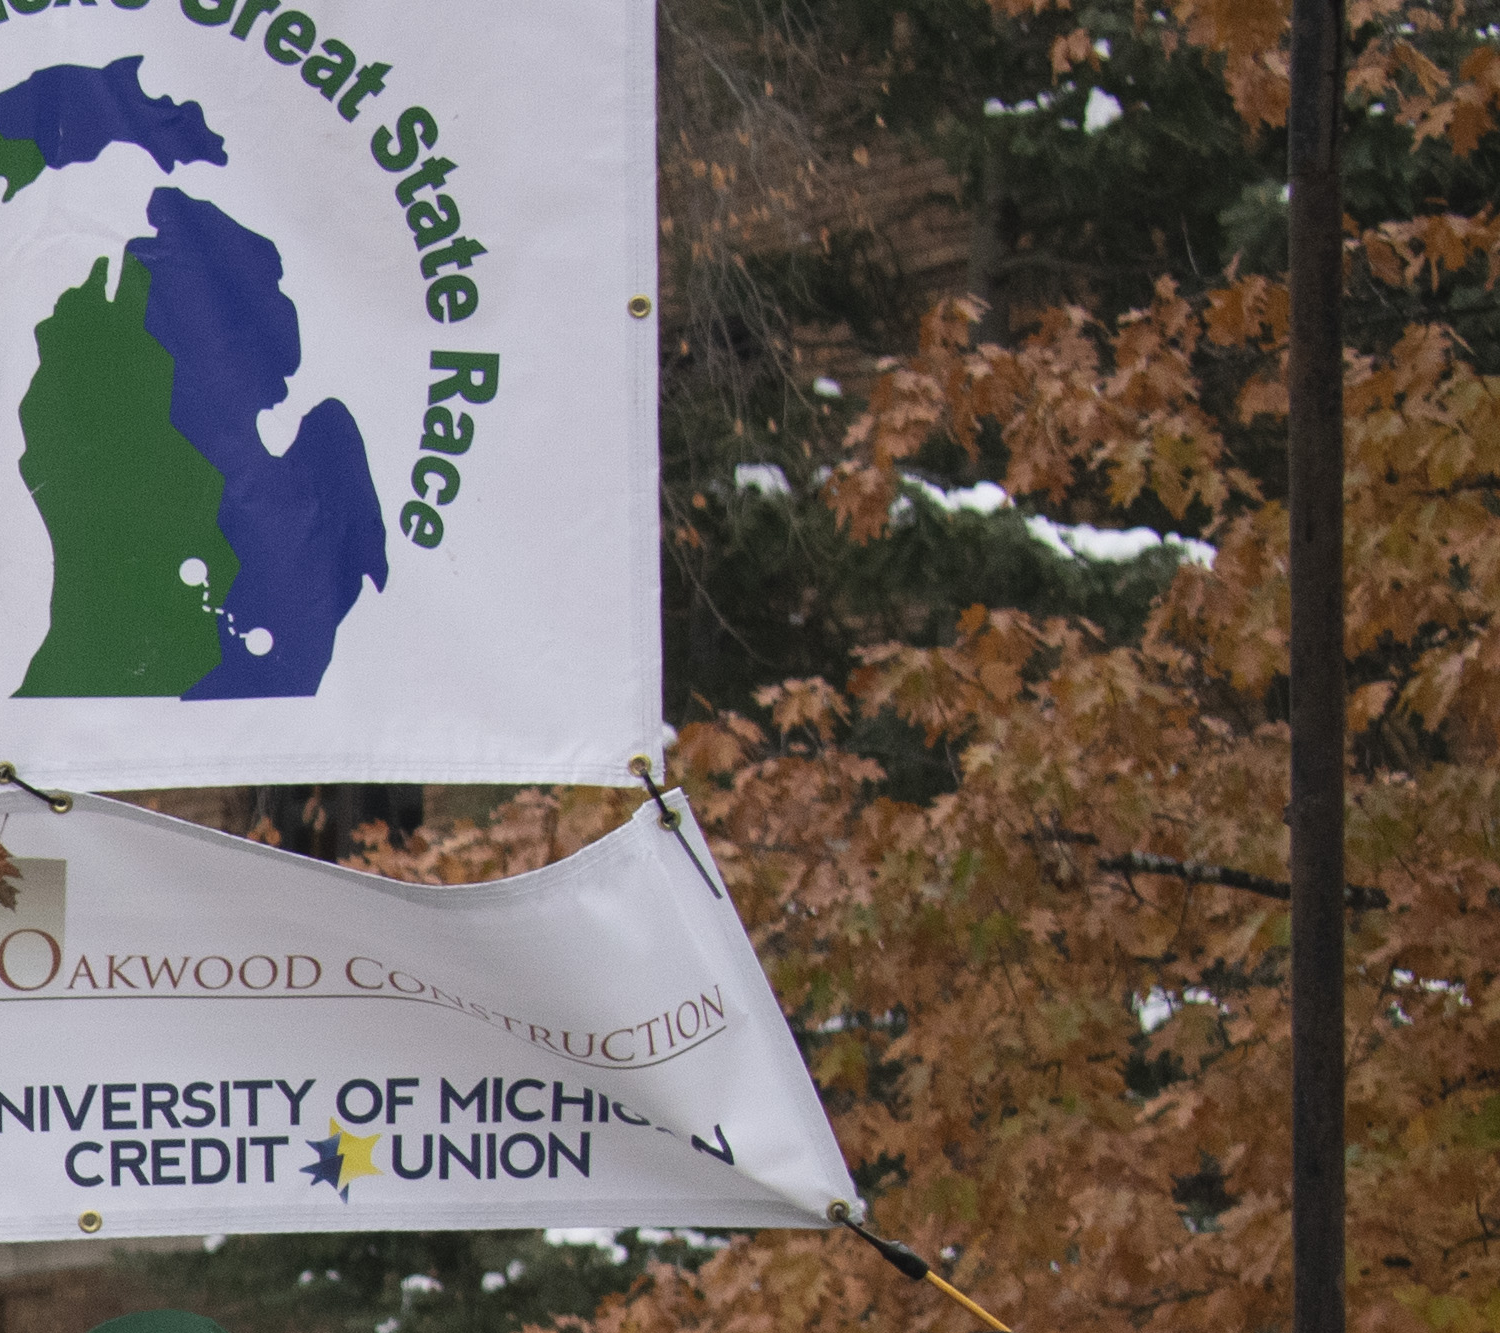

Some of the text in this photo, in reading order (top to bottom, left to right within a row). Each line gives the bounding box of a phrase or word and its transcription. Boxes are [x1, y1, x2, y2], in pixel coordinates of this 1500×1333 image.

[370, 107, 488, 324] State
[400, 350, 500, 550] Race
[345, 956, 727, 1066] CONSTRUCTION
[64, 1131, 591, 1187] CREDIT UNION
[336, 1077, 420, 1125] OF
[440, 1077, 735, 1167] MICHIGN
